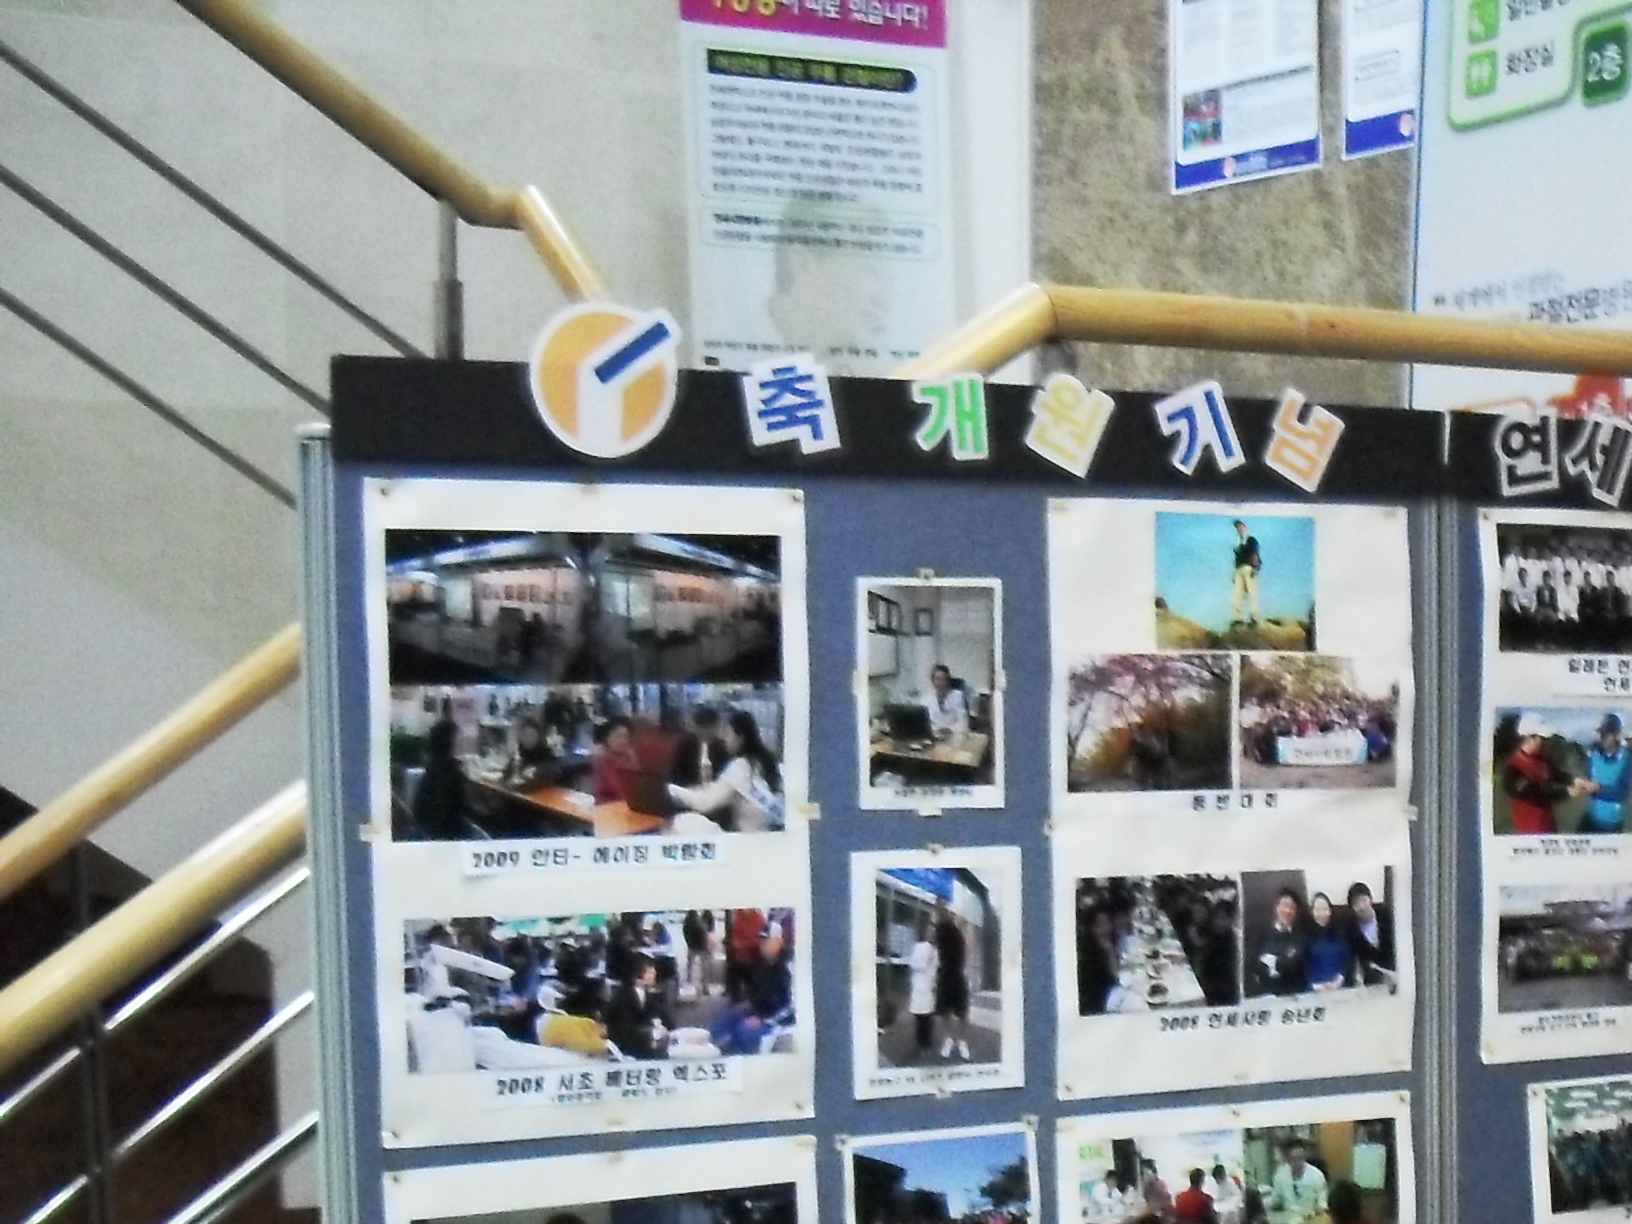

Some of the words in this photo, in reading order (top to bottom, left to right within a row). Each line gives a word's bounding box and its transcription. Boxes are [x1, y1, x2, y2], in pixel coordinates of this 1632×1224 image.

[1587, 42, 1623, 83] 2층
[757, 364, 825, 449] 축
[472, 851, 520, 869] 2009
[497, 1076, 545, 1096] 2008
